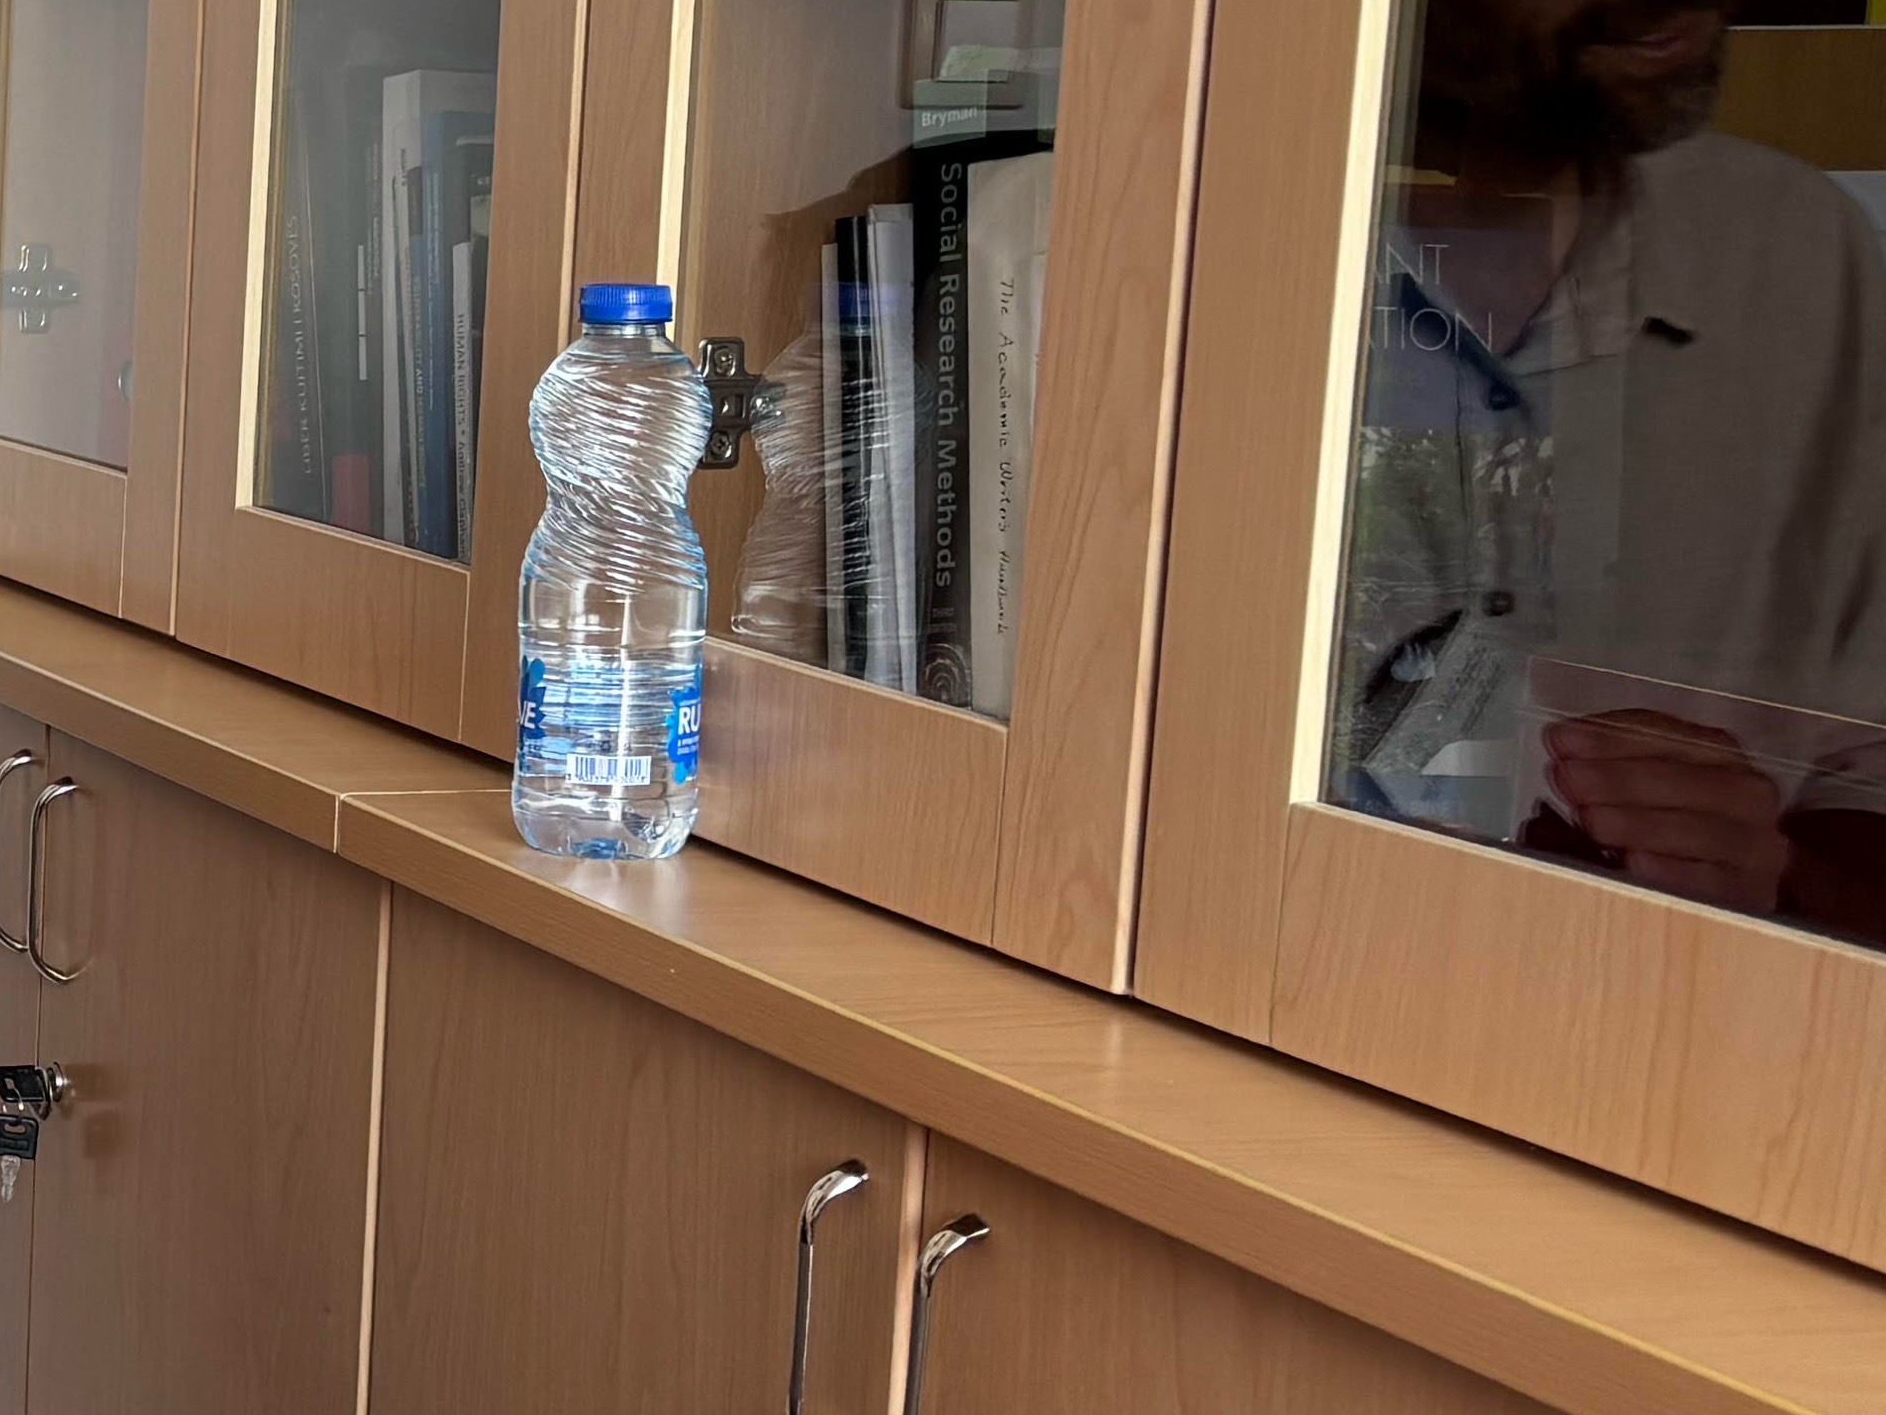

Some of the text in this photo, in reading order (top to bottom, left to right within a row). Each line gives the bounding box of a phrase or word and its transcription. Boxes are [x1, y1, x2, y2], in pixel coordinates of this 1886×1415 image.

[921, 106, 978, 127] Bryman
[935, 162, 961, 588] Social Research Methods
